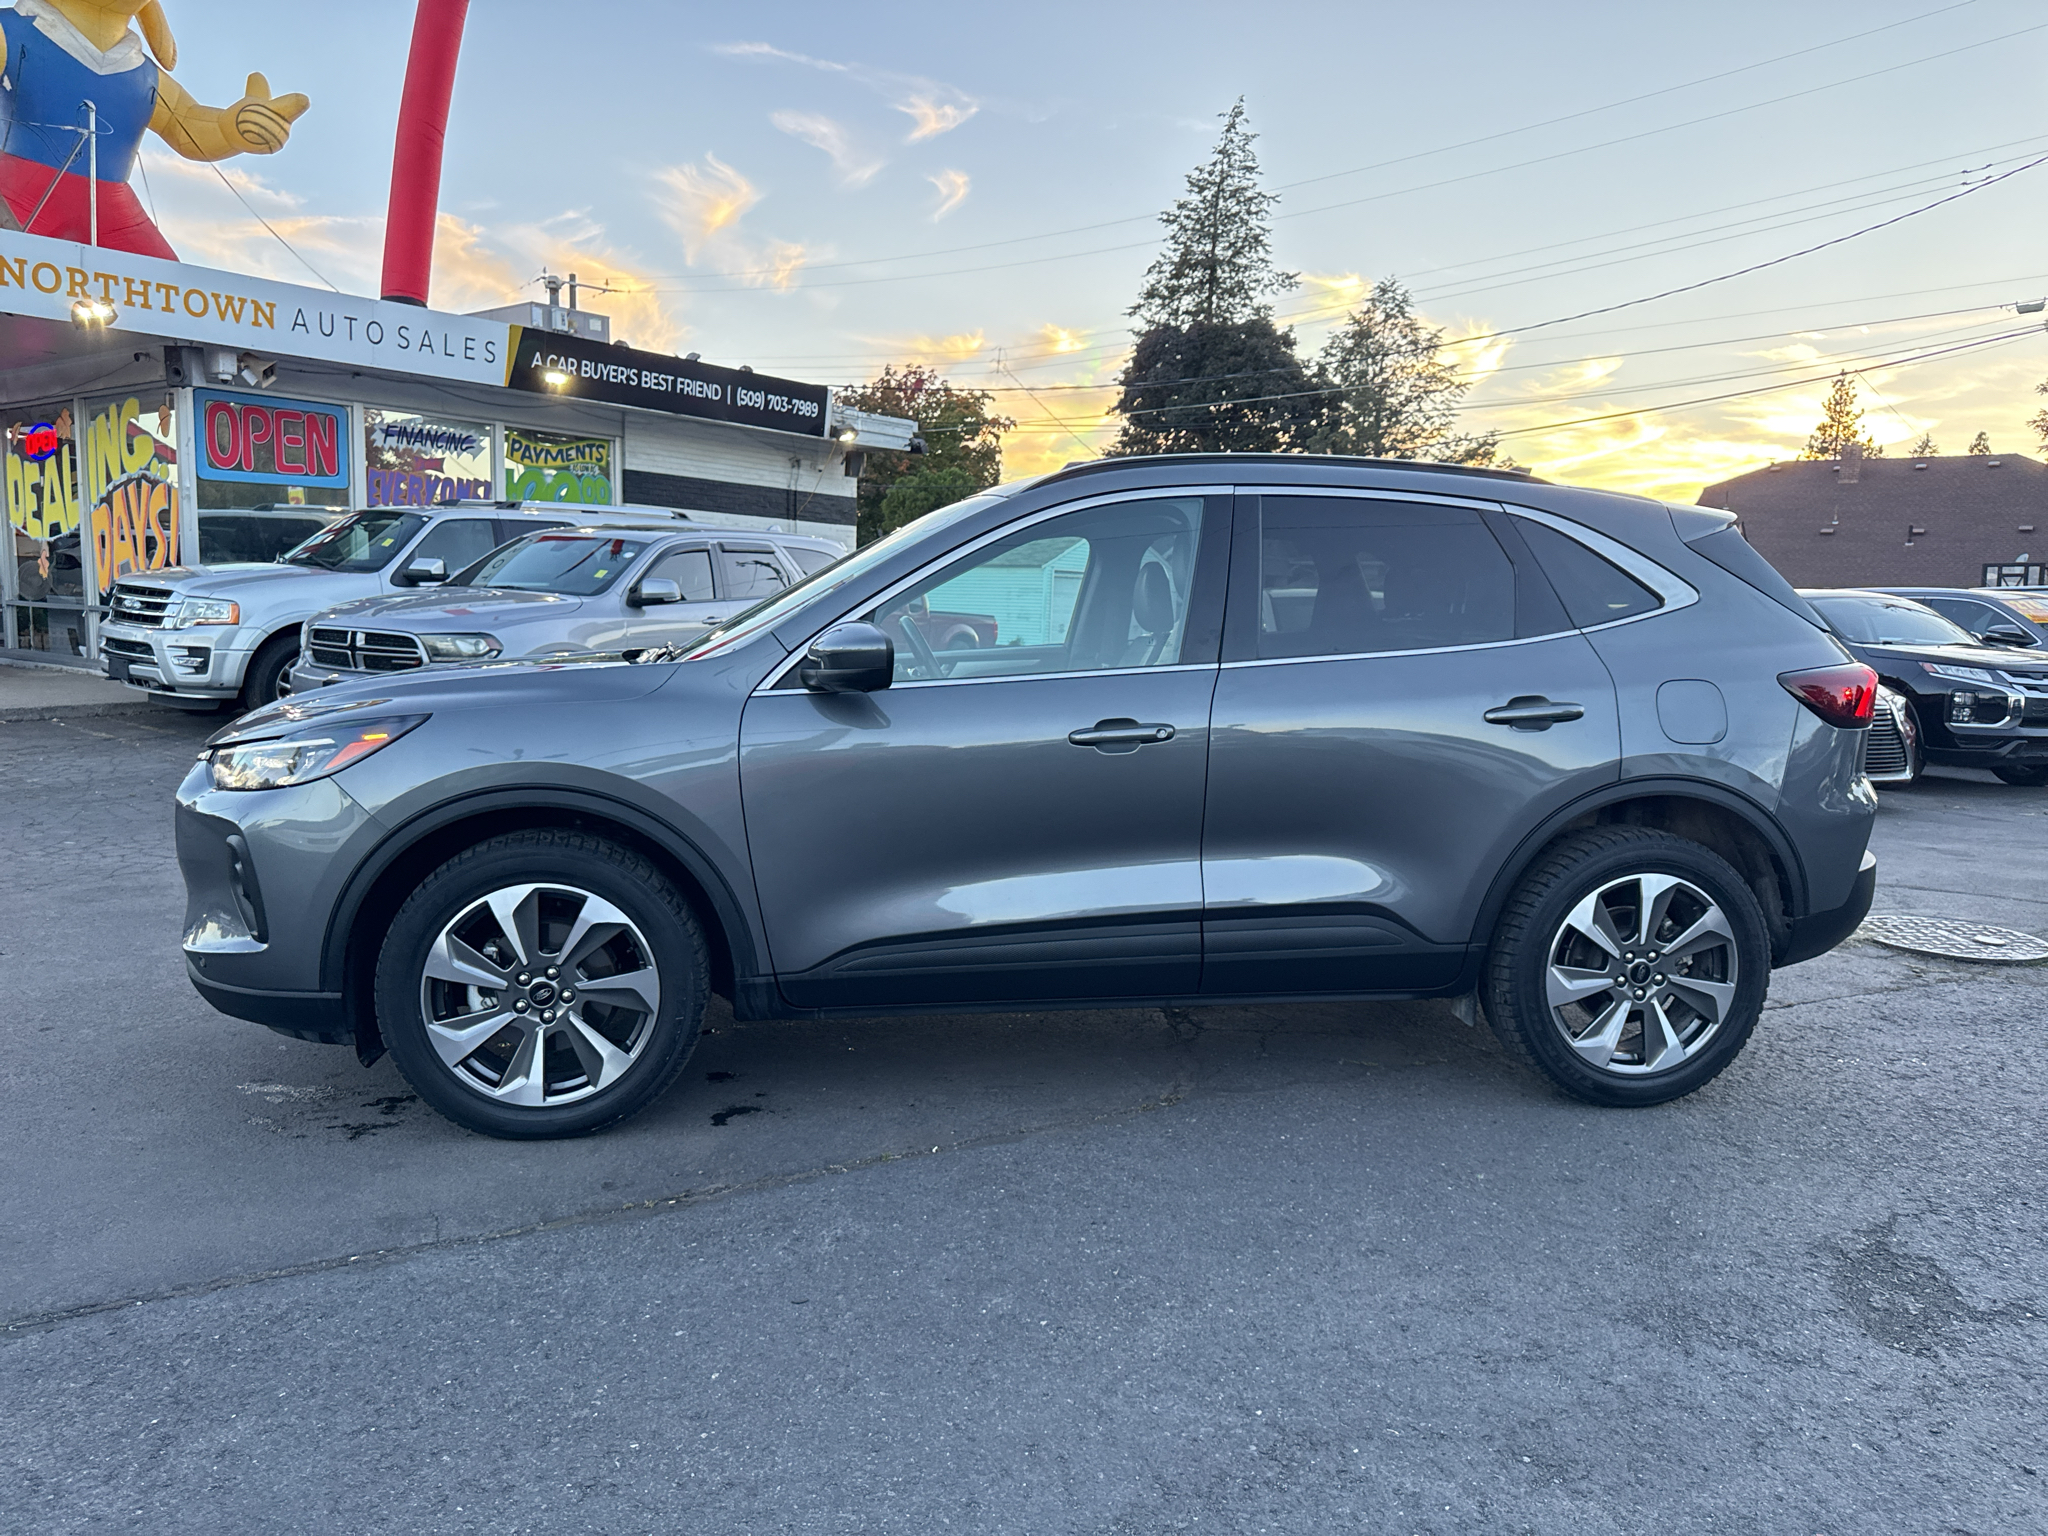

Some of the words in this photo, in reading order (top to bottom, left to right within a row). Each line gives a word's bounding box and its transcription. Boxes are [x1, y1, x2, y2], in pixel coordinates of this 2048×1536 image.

[0, 255, 277, 329] NORTHTOWN
[291, 308, 384, 345] AUTO
[397, 325, 496, 364] SALES
[531, 351, 543, 369] A
[546, 354, 577, 375] CAR
[580, 360, 638, 386] BUYER'S
[641, 371, 675, 393] BEST
[676, 377, 722, 401] FRIEND
[736, 387, 765, 411] (509)
[767, 394, 819, 418] 703-7989
[25, 429, 58, 456] OPEN
[206, 401, 339, 477] OPEN
[383, 424, 476, 452] FINANCING
[510, 438, 606, 465] PAYMENTS
